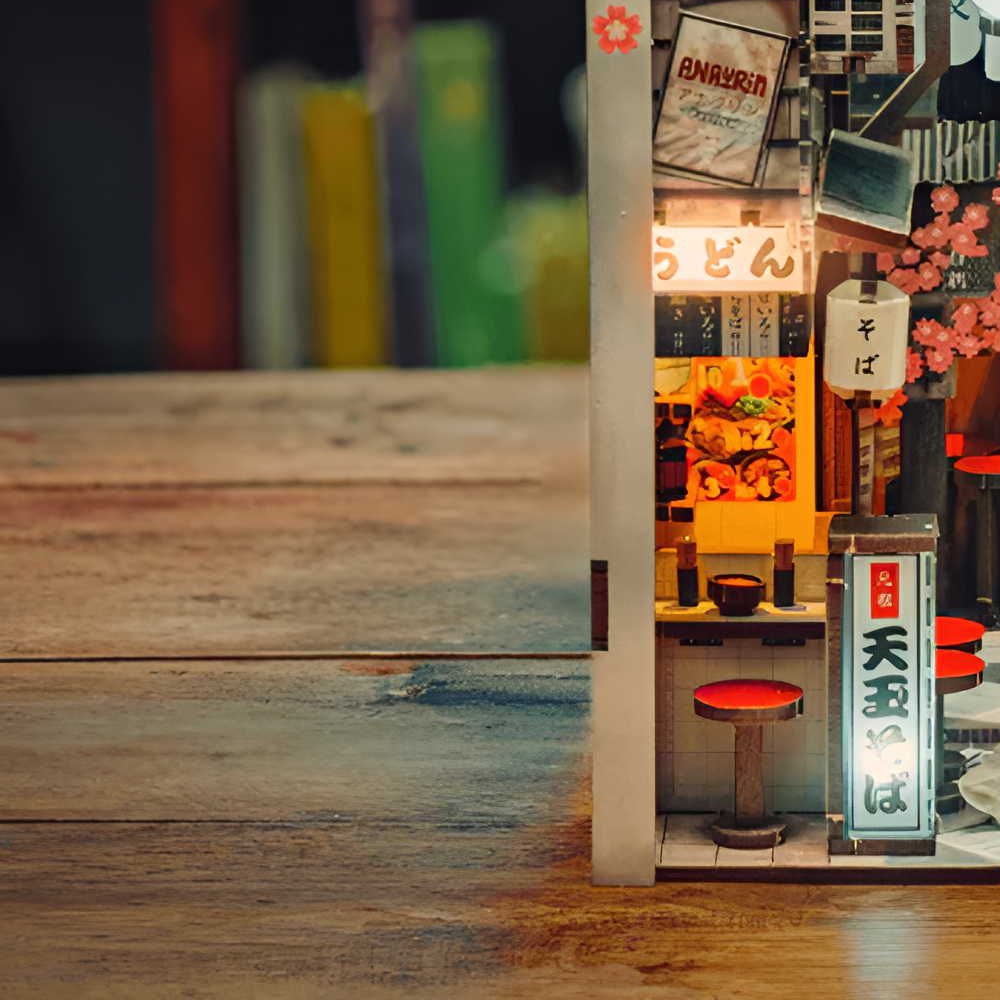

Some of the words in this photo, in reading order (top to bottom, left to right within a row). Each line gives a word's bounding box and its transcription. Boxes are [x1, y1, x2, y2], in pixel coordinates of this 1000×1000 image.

[653, 236, 797, 281] うどん
[854, 317, 882, 376] そば
